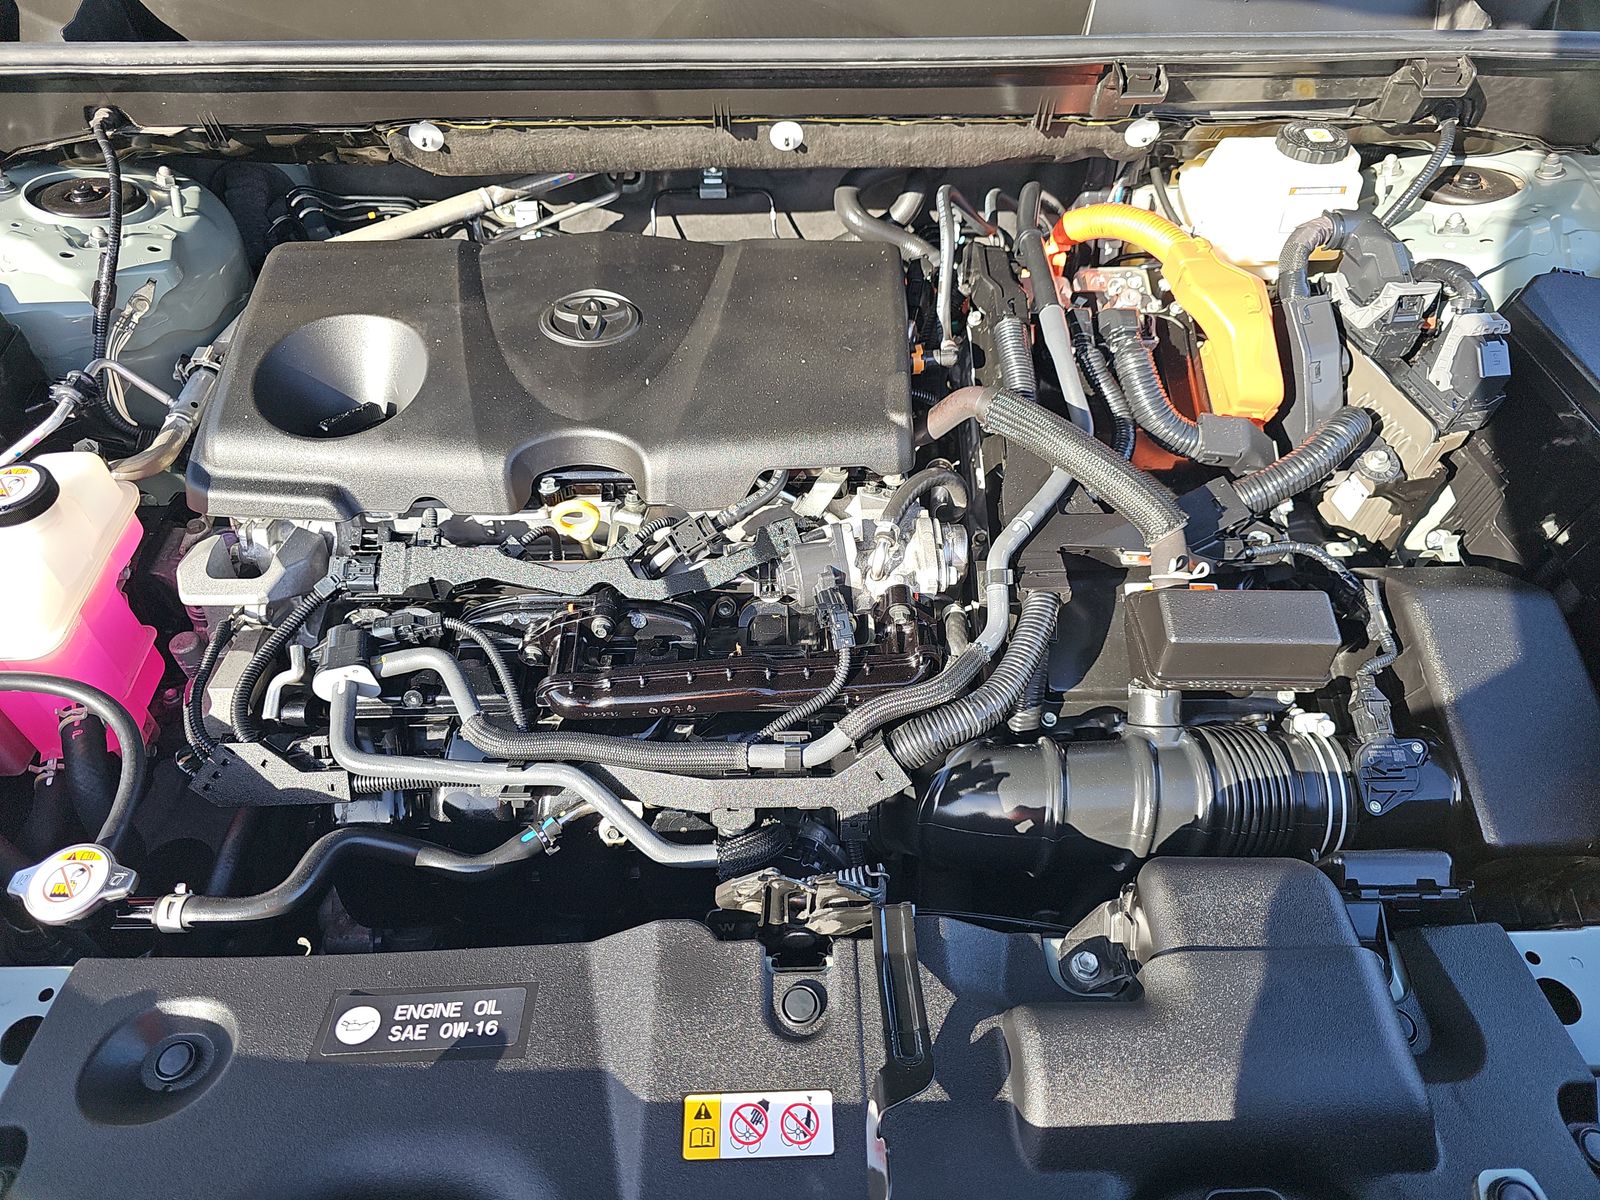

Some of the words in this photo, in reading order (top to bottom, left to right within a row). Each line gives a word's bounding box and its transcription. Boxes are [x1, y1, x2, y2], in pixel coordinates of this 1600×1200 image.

[393, 1001, 463, 1021] ENGINE
[473, 999, 502, 1016] OIL
[388, 1023, 429, 1042] SAE
[439, 1020, 499, 1039] 0W-16
